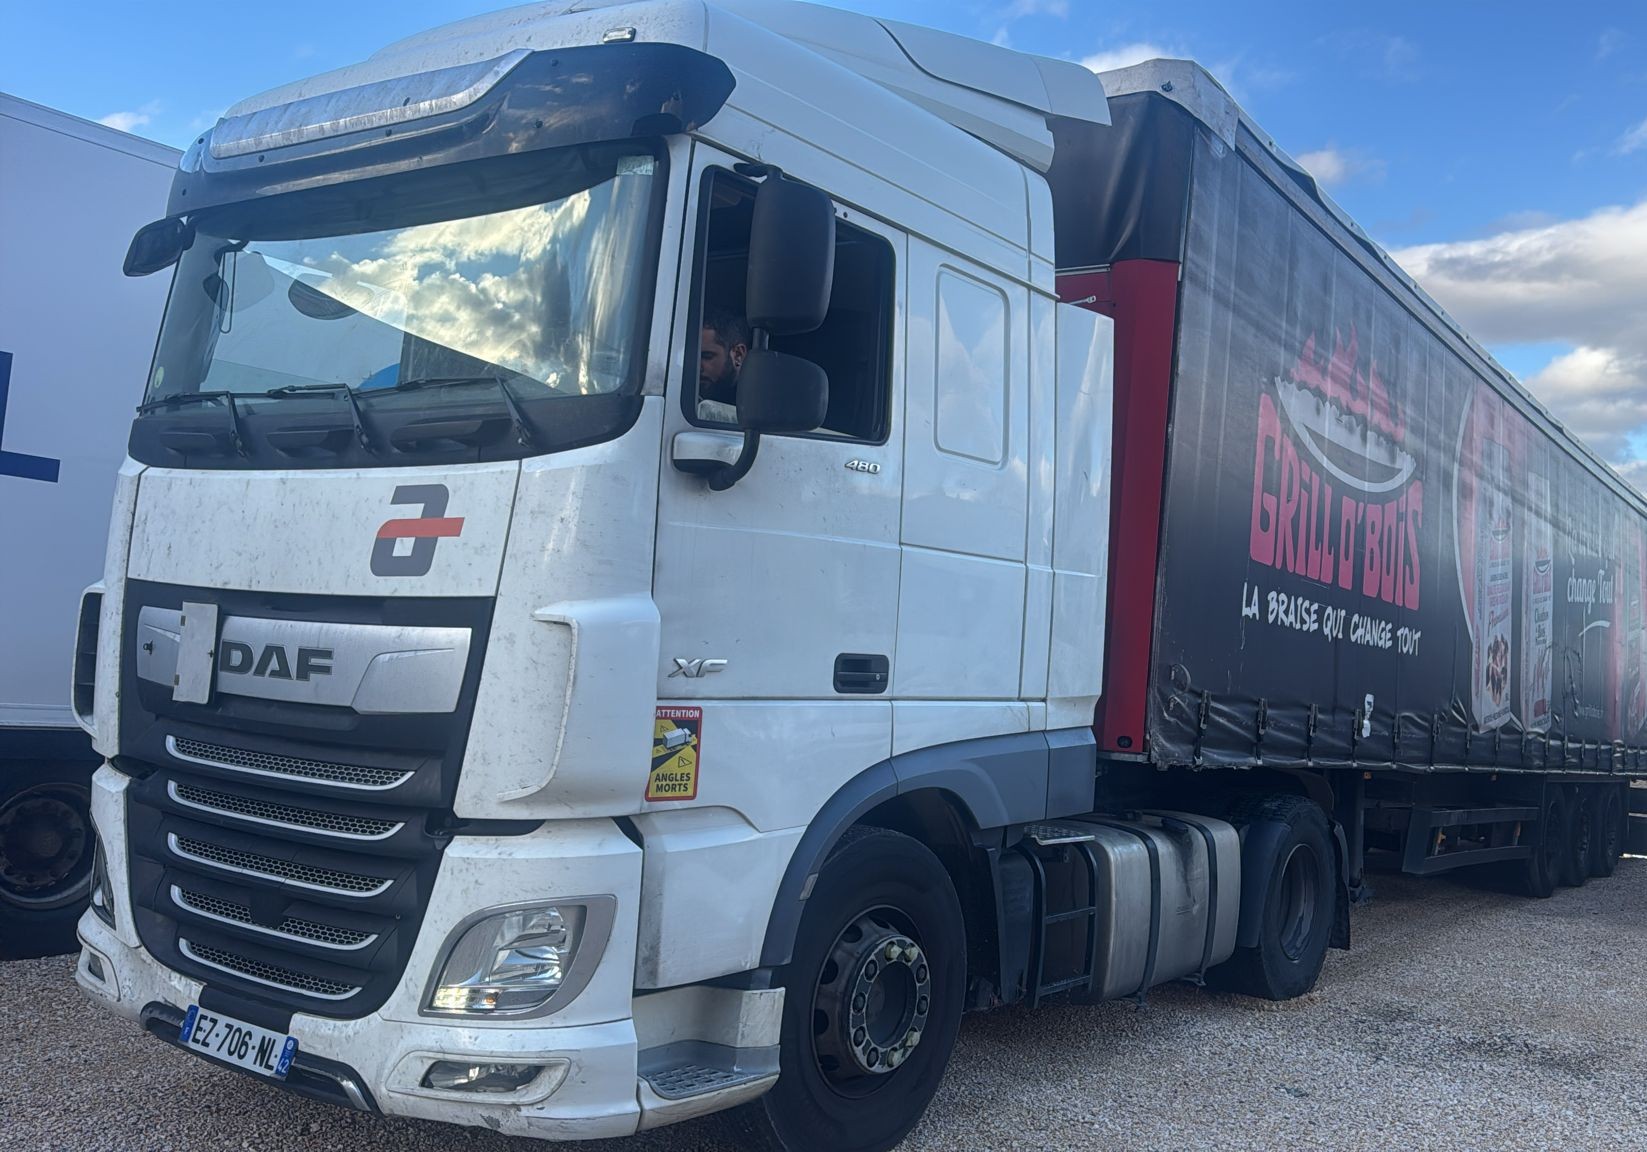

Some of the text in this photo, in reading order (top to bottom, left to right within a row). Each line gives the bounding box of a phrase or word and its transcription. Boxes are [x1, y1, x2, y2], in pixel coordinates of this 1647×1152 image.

[844, 460, 881, 474] 480
[1242, 582, 1422, 656] LA BRAISE QUI CHANGE TOUT
[219, 639, 336, 682] DAF
[667, 658, 728, 678] XF
[656, 709, 700, 719] ATTENTION
[654, 772, 691, 783] ANGLES
[655, 783, 689, 793] MORTS
